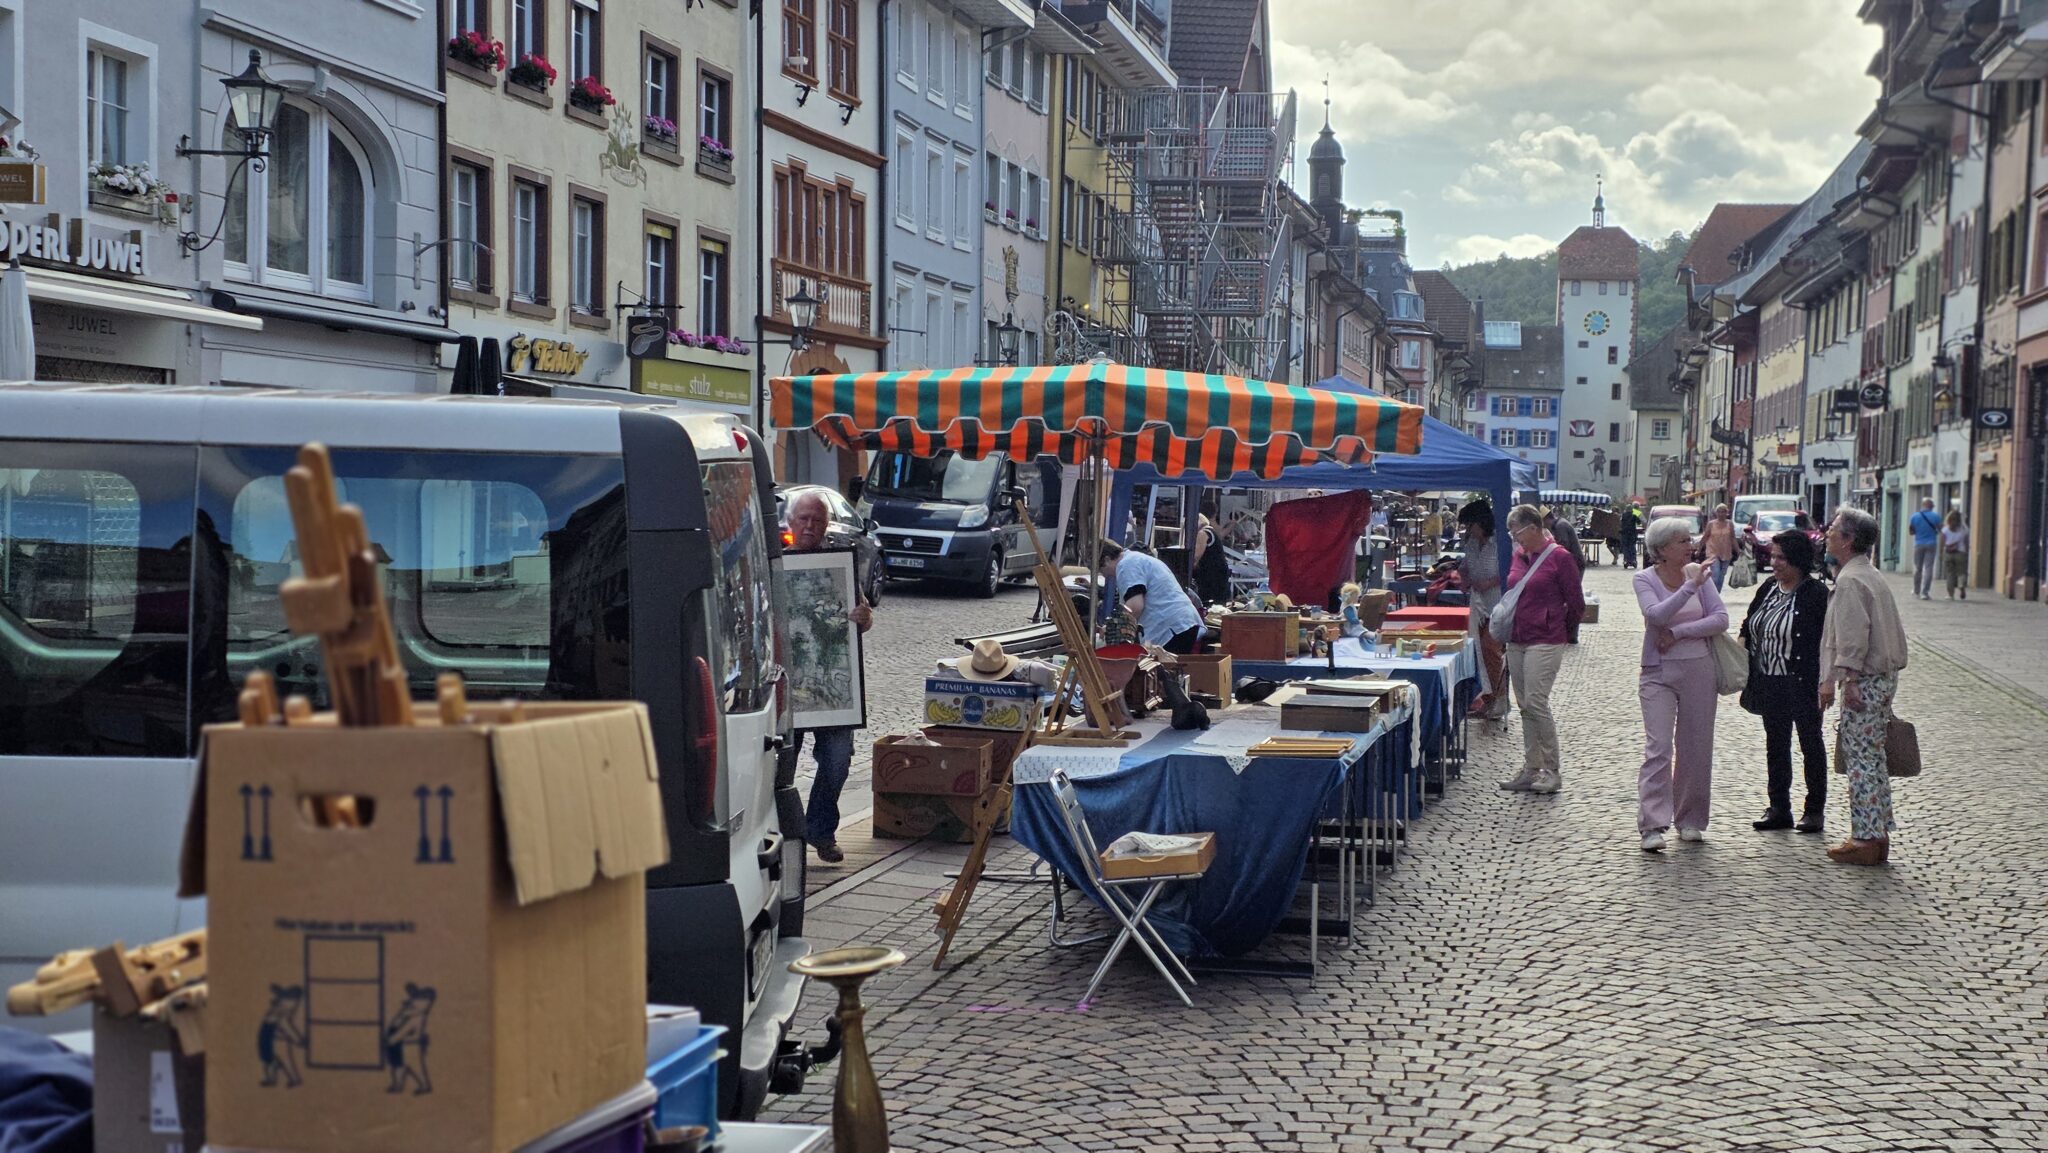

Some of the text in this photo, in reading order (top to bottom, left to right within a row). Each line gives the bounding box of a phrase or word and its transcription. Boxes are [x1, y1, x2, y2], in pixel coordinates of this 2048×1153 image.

[67, 315, 117, 335] JUWEL
[689, 373, 711, 396] stulz
[935, 682, 1017, 696] PREMIUM BANANAS
